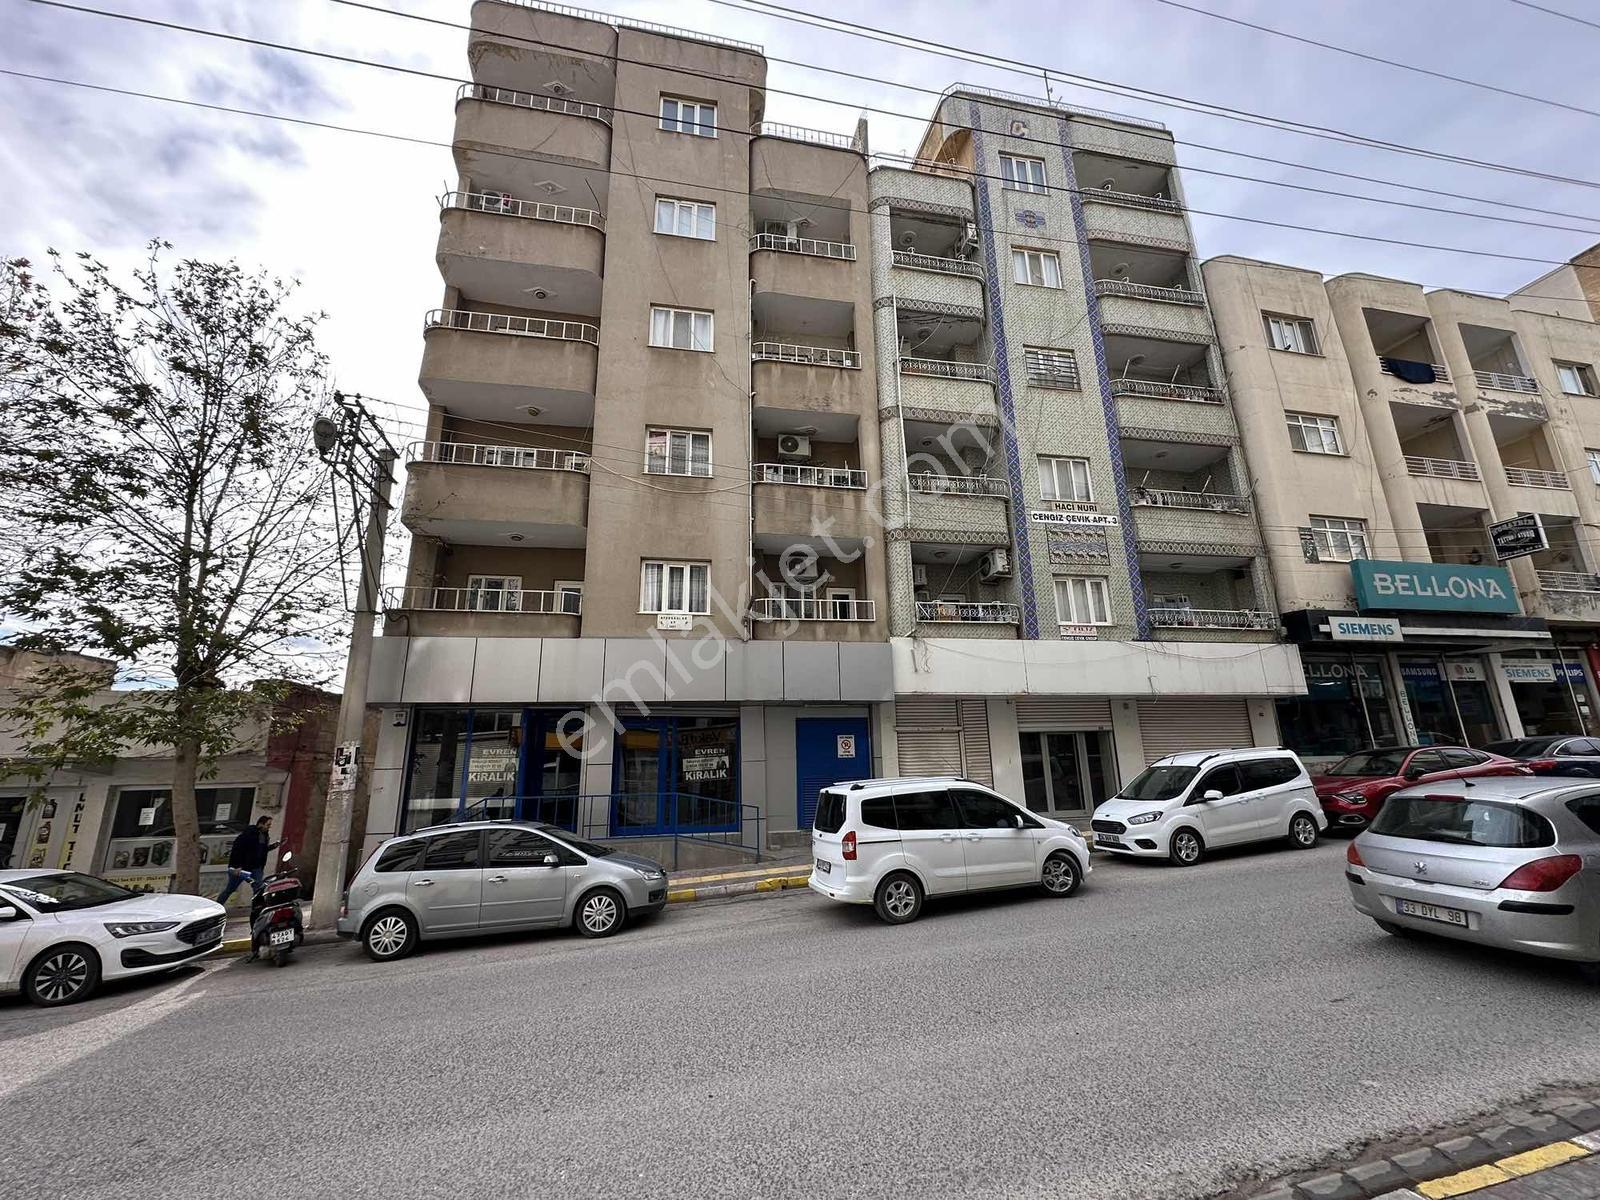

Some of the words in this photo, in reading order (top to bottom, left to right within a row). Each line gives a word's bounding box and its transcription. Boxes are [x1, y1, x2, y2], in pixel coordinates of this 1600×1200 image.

[1054, 503, 1075, 511] HACI
[1373, 573, 1507, 600] BELLONA
[1338, 622, 1395, 636] SIEMENS
[1303, 663, 1369, 679] ELLONA
[1401, 667, 1438, 676] SAMSUNG
[1465, 666, 1475, 674] LG
[1504, 668, 1551, 678] SIEMENS
[1403, 902, 1416, 914] 33
[1421, 903, 1440, 918] DYL
[1448, 910, 1462, 923] 98
